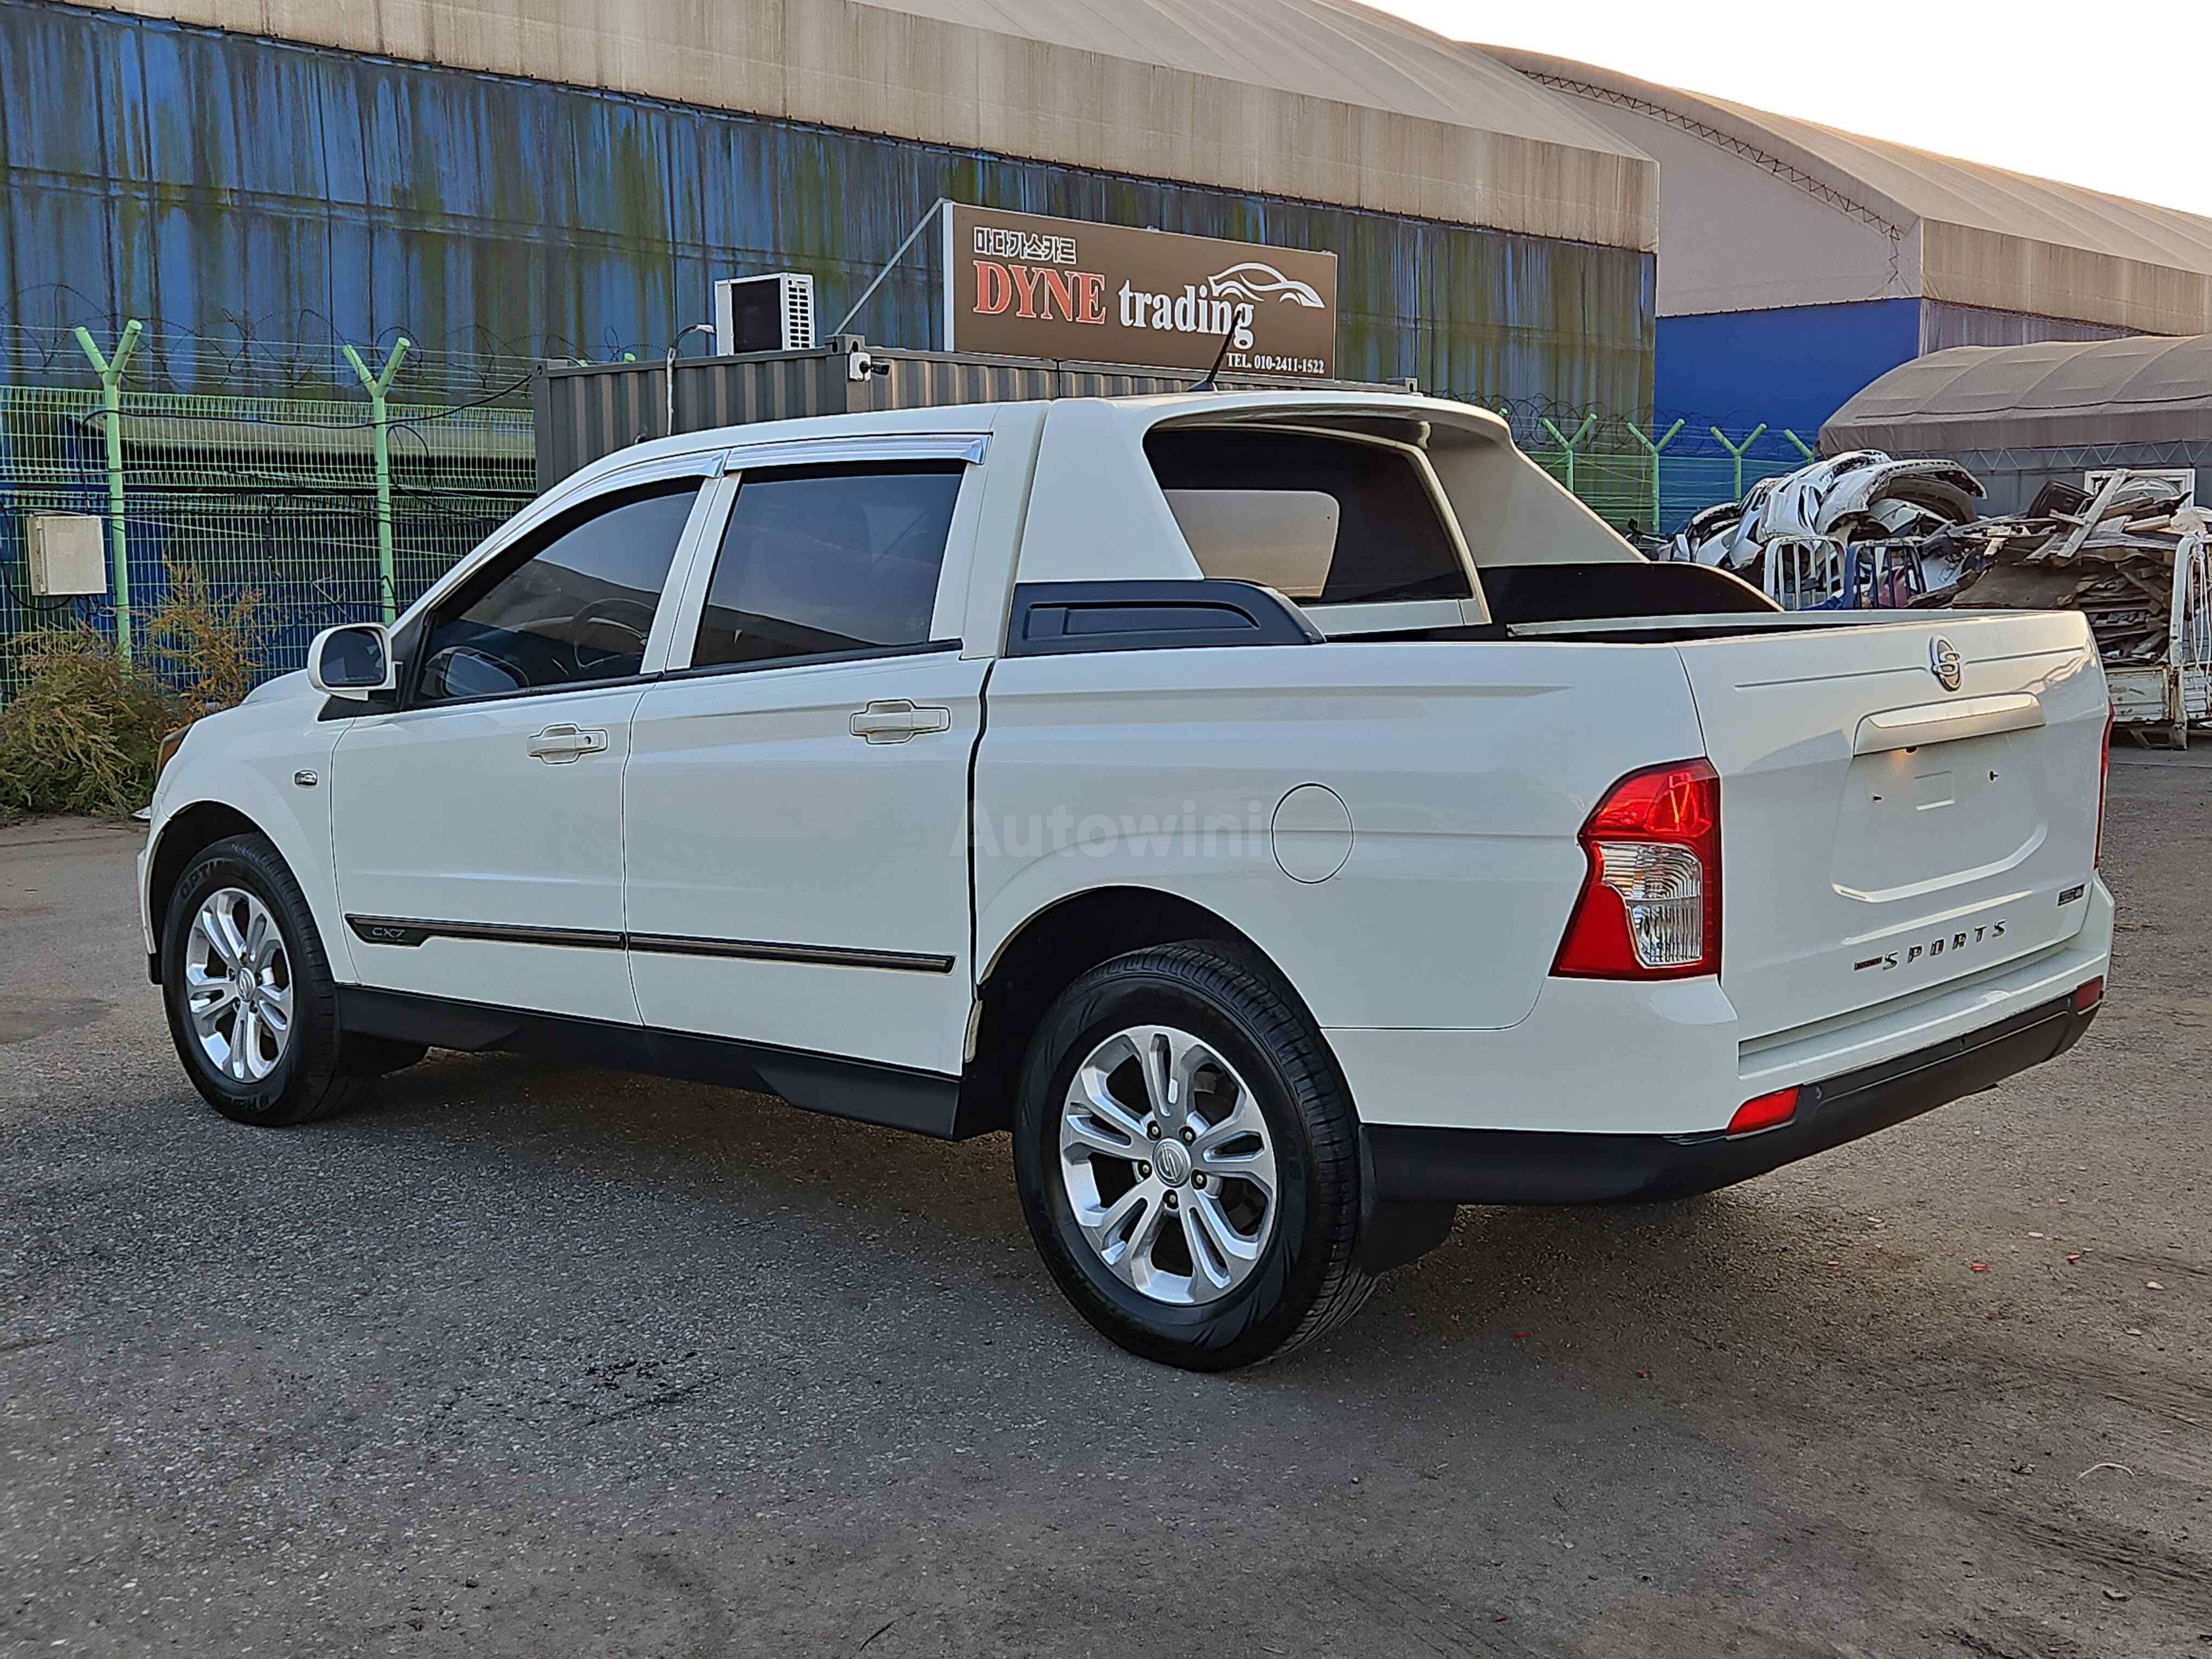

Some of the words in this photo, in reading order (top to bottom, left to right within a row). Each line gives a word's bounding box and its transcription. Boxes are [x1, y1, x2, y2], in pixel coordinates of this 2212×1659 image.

[974, 227, 1077, 265] 마다가스카르
[973, 260, 1106, 324] DYNE
[1118, 279, 1255, 350] trading
[1227, 353, 1252, 369] TEL.
[1254, 355, 1324, 374] 010-2411-1522
[372, 928, 406, 938] CX7
[1882, 919, 2007, 970] SPORTS
